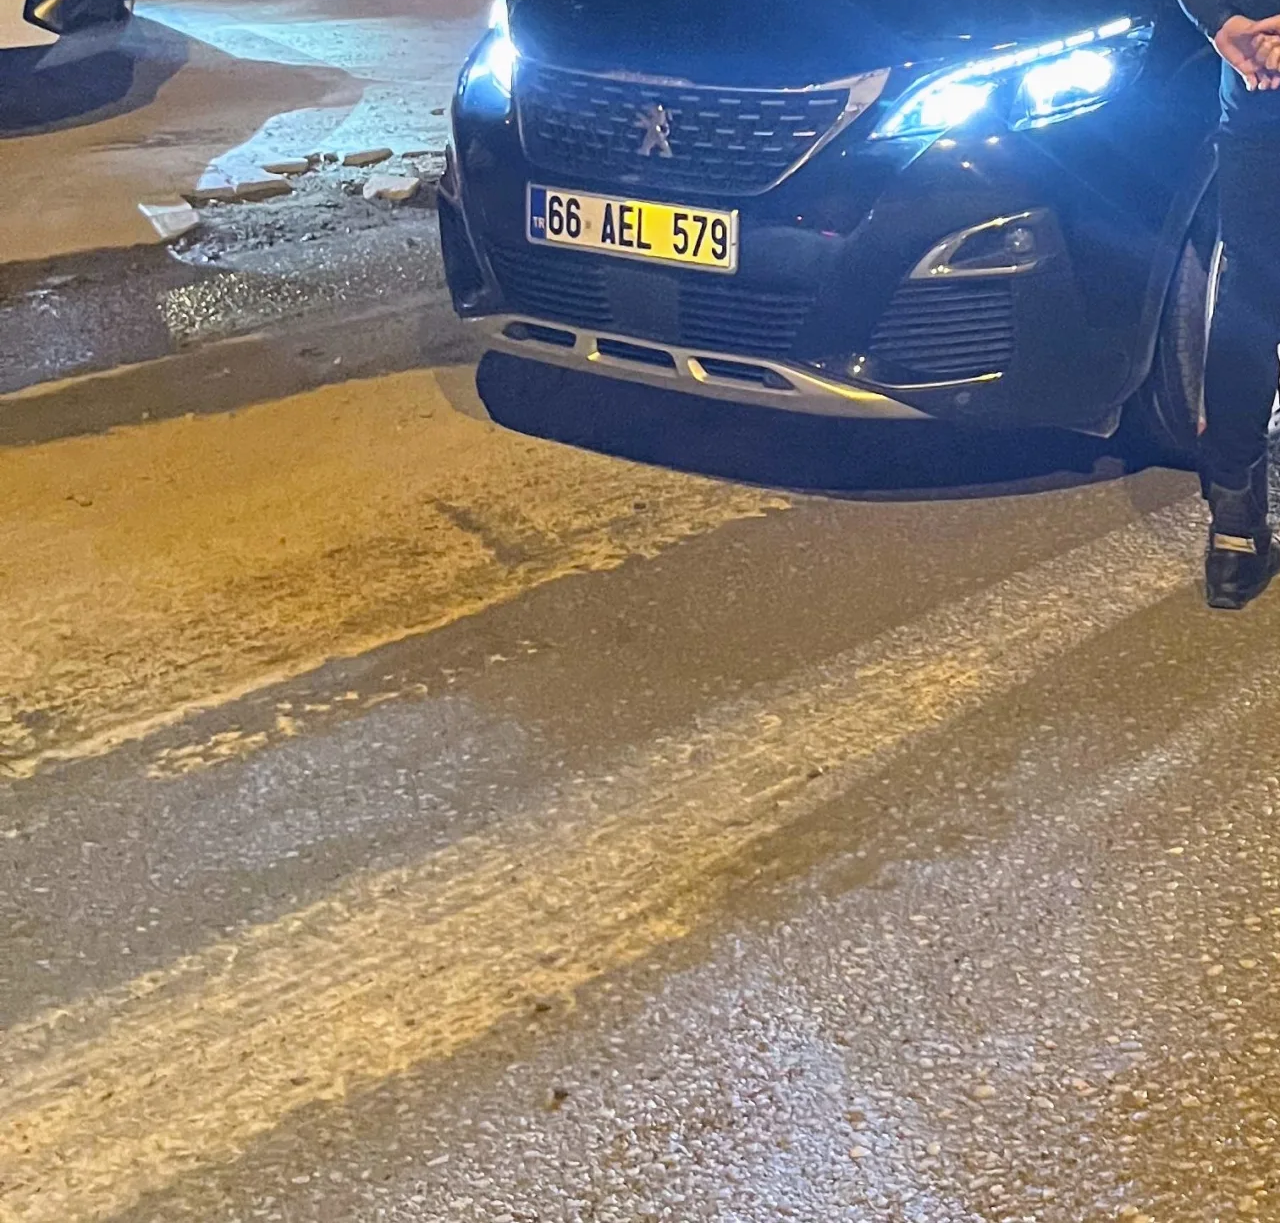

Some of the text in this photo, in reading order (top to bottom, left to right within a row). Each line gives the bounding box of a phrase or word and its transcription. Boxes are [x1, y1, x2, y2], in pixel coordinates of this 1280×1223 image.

[532, 216, 545, 229] TR
[549, 195, 728, 260] 66 AEL 579
